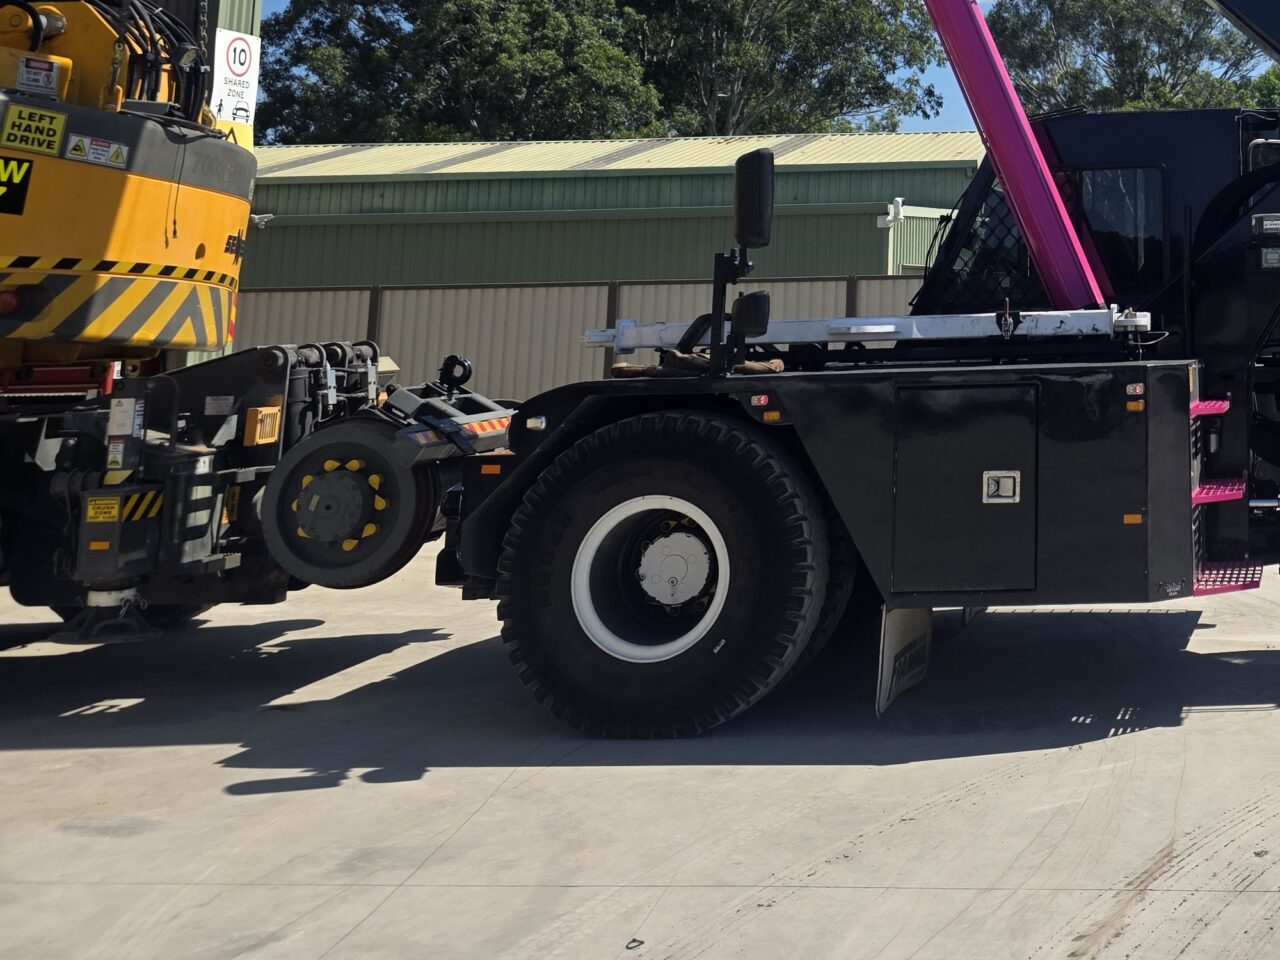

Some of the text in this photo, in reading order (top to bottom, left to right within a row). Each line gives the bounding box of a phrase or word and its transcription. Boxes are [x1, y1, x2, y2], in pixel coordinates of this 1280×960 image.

[233, 47, 247, 66] 10
[224, 77, 250, 89] SHARED
[227, 89, 245, 99] ZONE
[17, 110, 57, 126] LEFT
[11, 121, 57, 137] HAND
[6, 132, 56, 150] DRIVE
